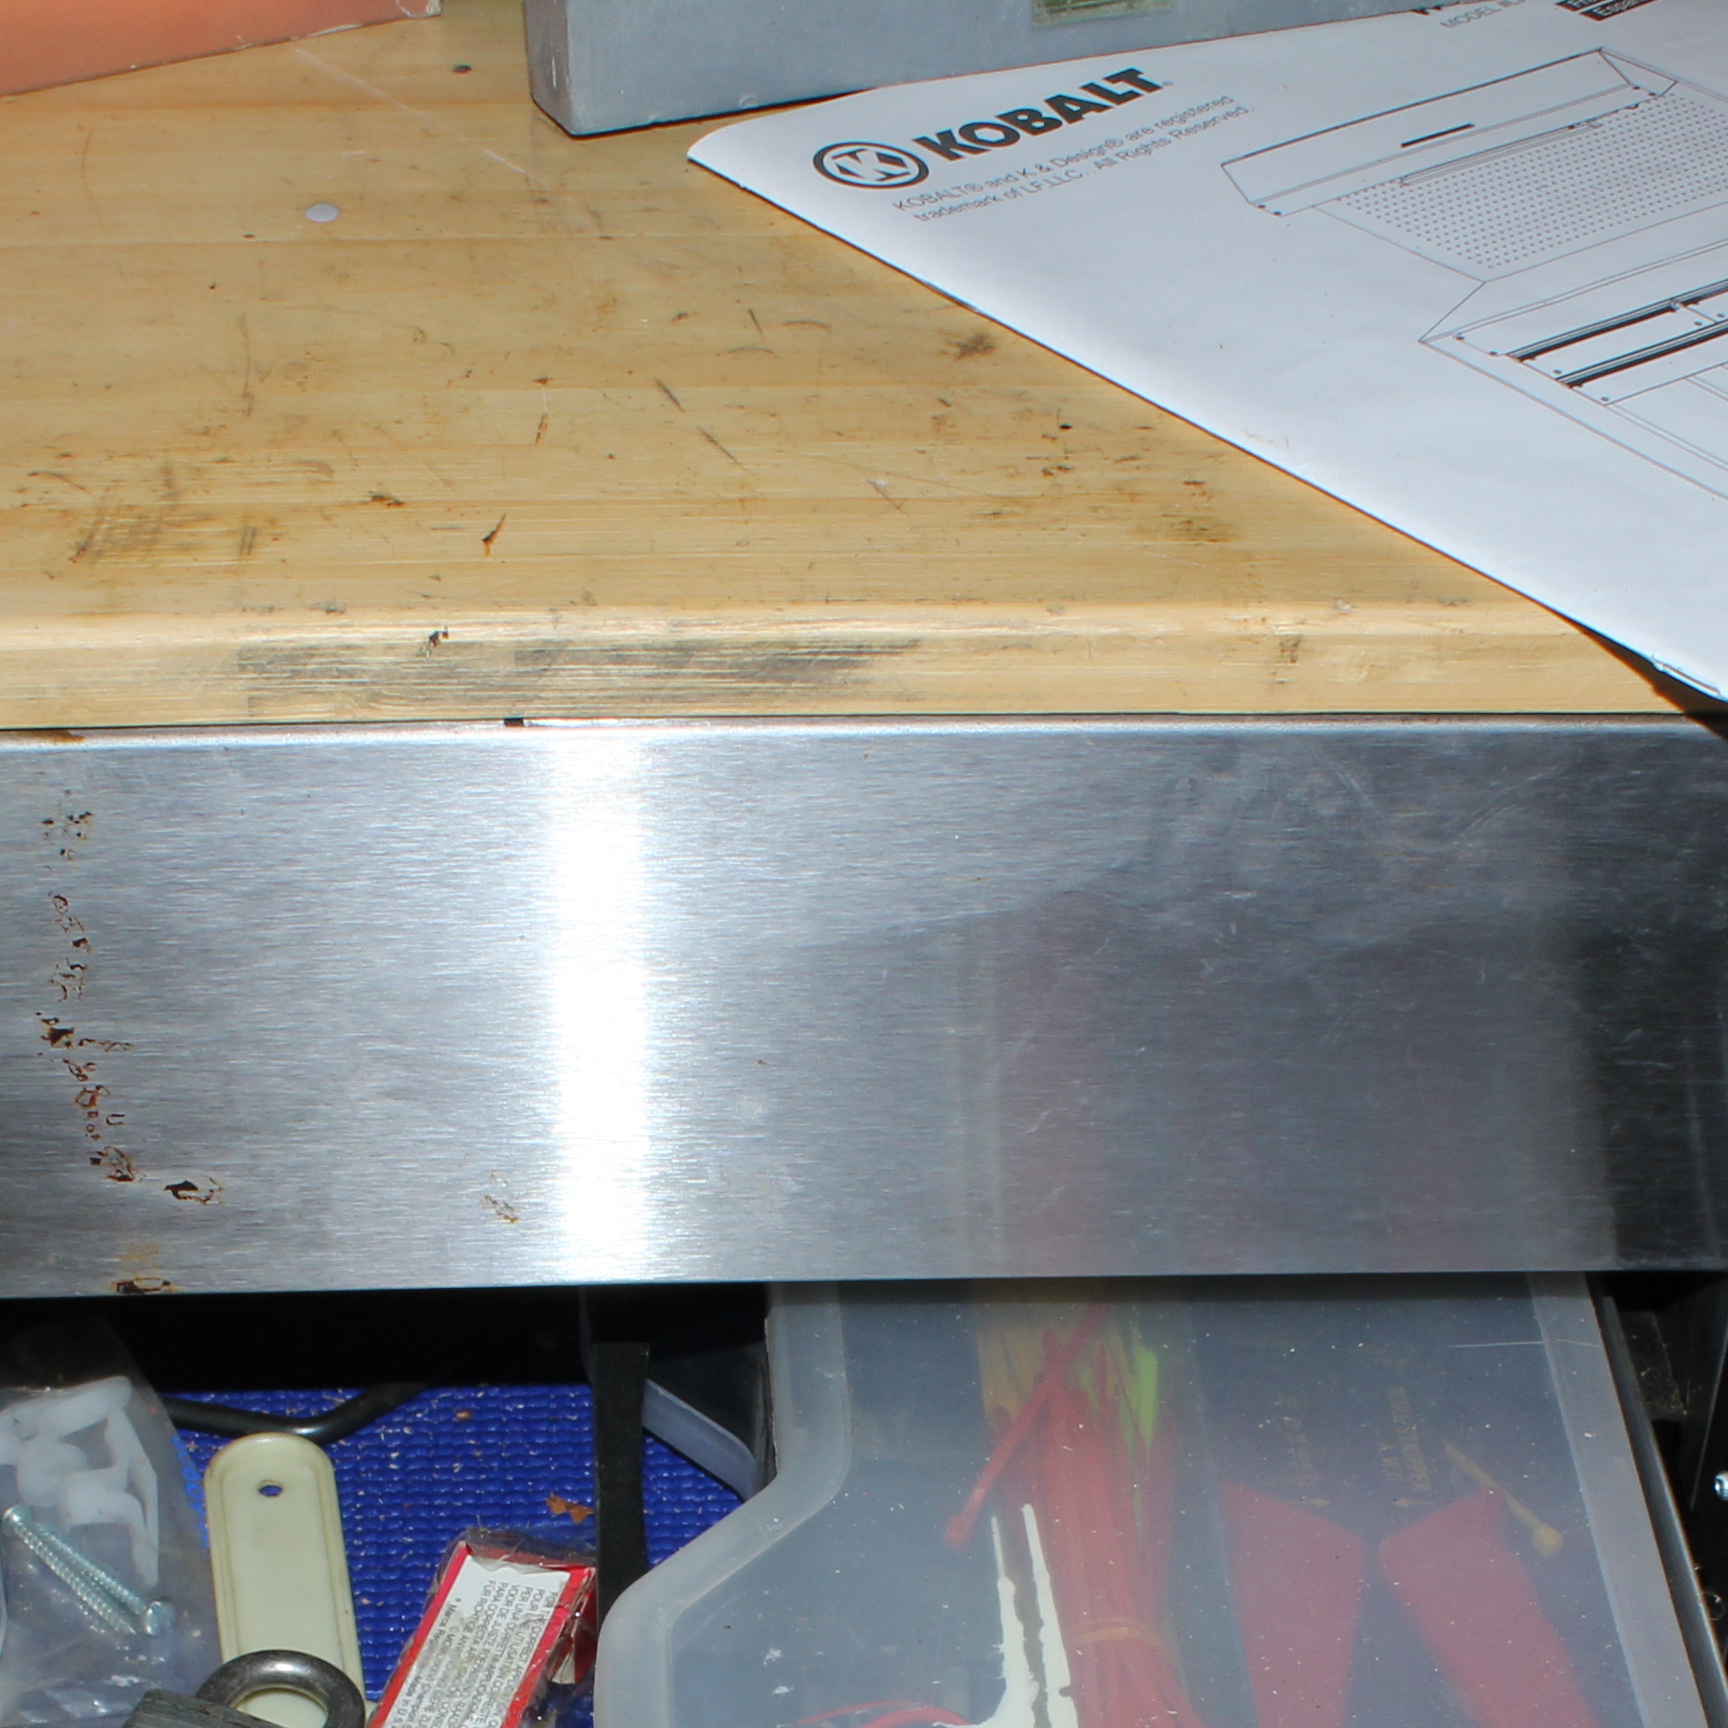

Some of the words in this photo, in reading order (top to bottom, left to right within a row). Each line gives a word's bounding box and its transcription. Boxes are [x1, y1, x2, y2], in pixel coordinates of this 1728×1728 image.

[912, 66, 1164, 162] KOBALT
[985, 173, 1019, 190] and
[1017, 167, 1037, 180] K
[1125, 126, 1154, 142] are
[1154, 94, 1235, 130] registered
[913, 193, 1004, 222] trademark
[1003, 187, 1024, 200] of
[1094, 155, 1119, 170] All
[1115, 137, 1172, 162] Rights
[1169, 105, 1255, 140] Reserved.
[518, 1625, 542, 1663] CORRECT
